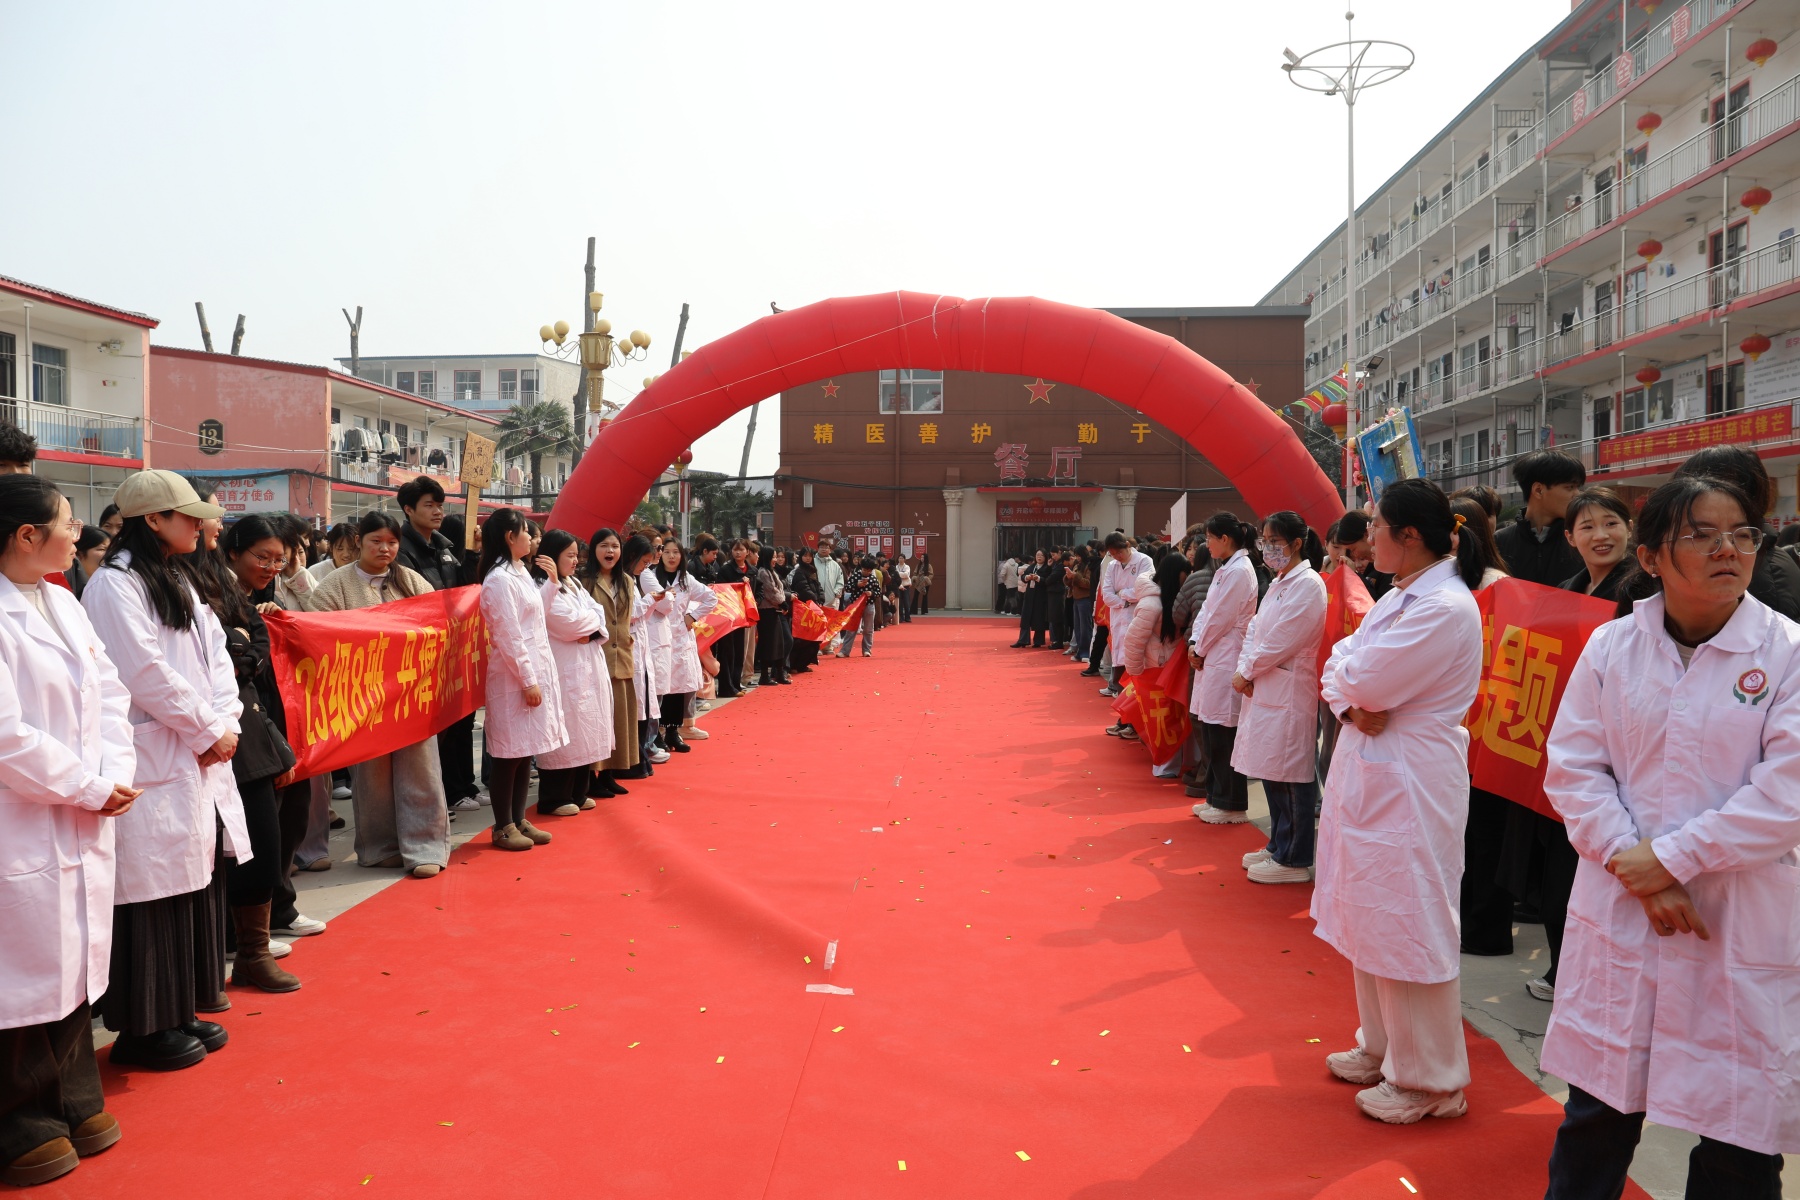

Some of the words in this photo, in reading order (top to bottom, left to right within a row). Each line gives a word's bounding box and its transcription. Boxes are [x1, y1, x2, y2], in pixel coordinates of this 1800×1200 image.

[813, 423, 992, 445] 精医善护
[1077, 423, 1152, 445] 勤于
[1686, 412, 1785, 446] 今朝出鞘试锋芒
[994, 442, 1082, 479] 餐厅
[295, 631, 390, 746] 23级8班
[1467, 614, 1563, 769] 题
